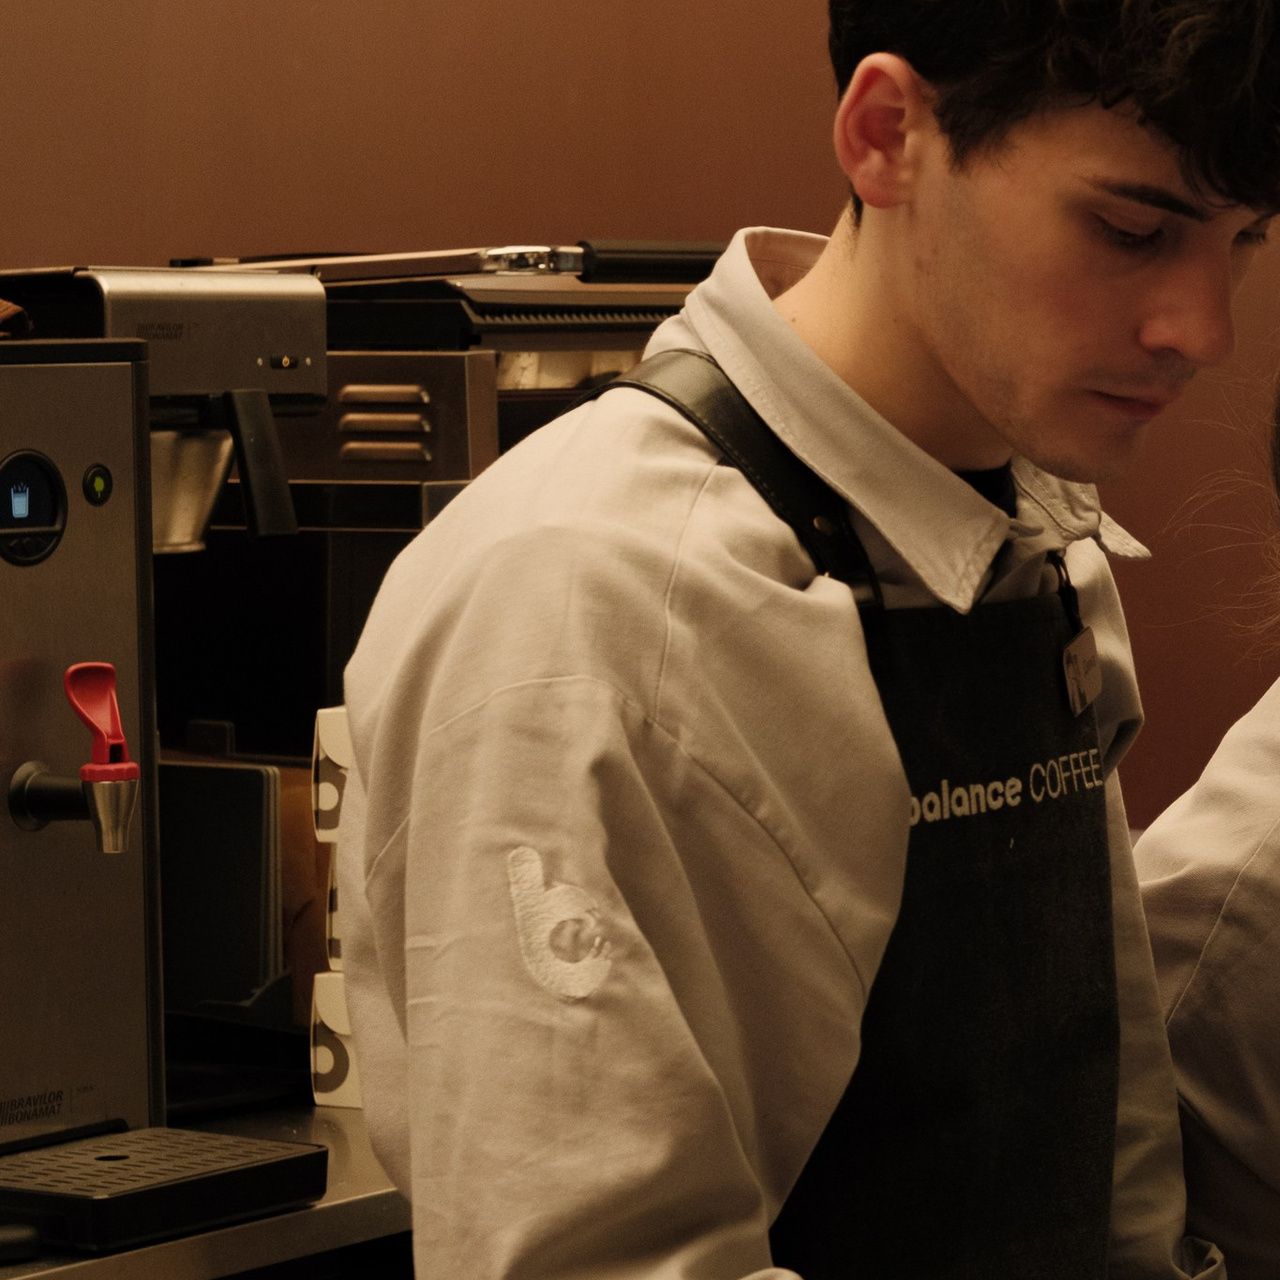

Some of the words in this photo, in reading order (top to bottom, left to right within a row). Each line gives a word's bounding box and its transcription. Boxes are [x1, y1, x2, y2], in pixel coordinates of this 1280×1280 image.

[1029, 748, 1104, 803] COFFEE
[9, 1090, 64, 1111] BRAVILOR
[8, 1103, 62, 1125] BONAMAT
